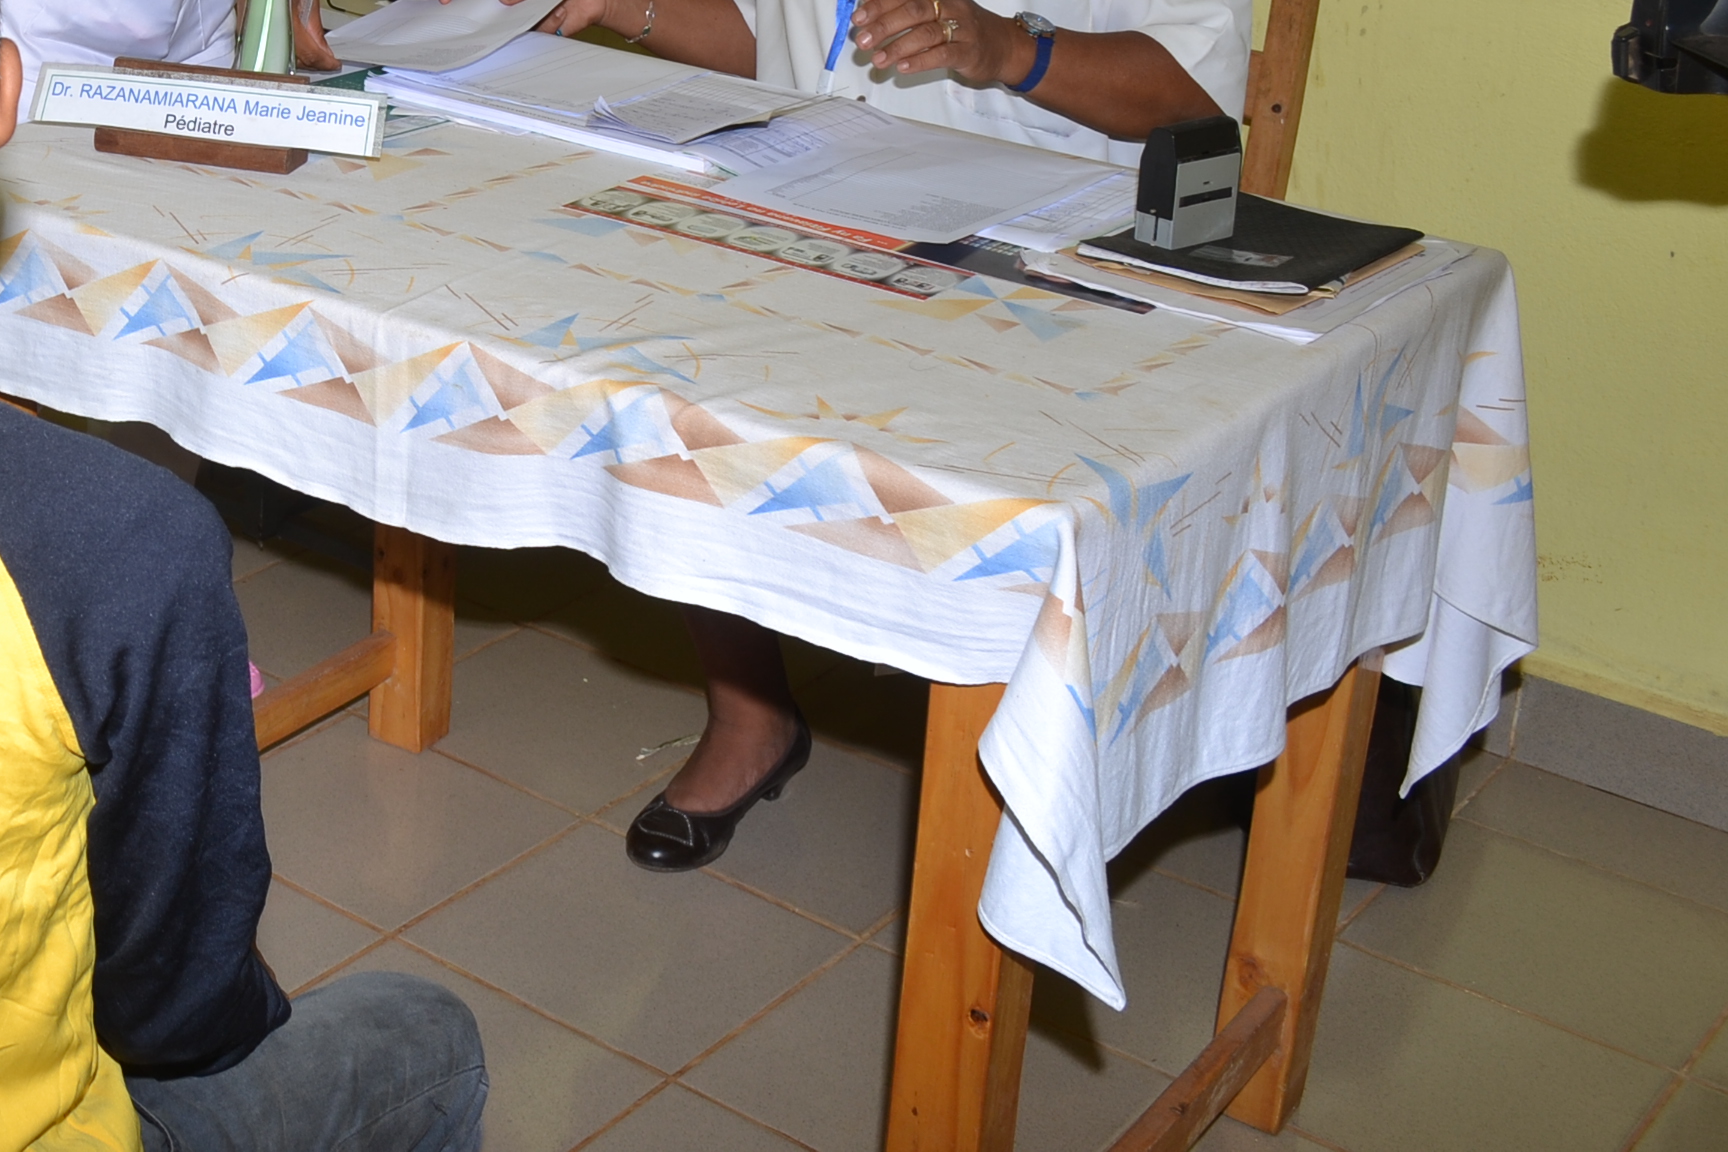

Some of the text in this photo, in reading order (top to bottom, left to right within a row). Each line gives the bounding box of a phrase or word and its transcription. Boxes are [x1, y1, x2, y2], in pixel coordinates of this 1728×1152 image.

[51, 81, 366, 128] Dr. RAZANAMIARANA Marie Jeanine
[163, 113, 235, 137] Pédiatre
